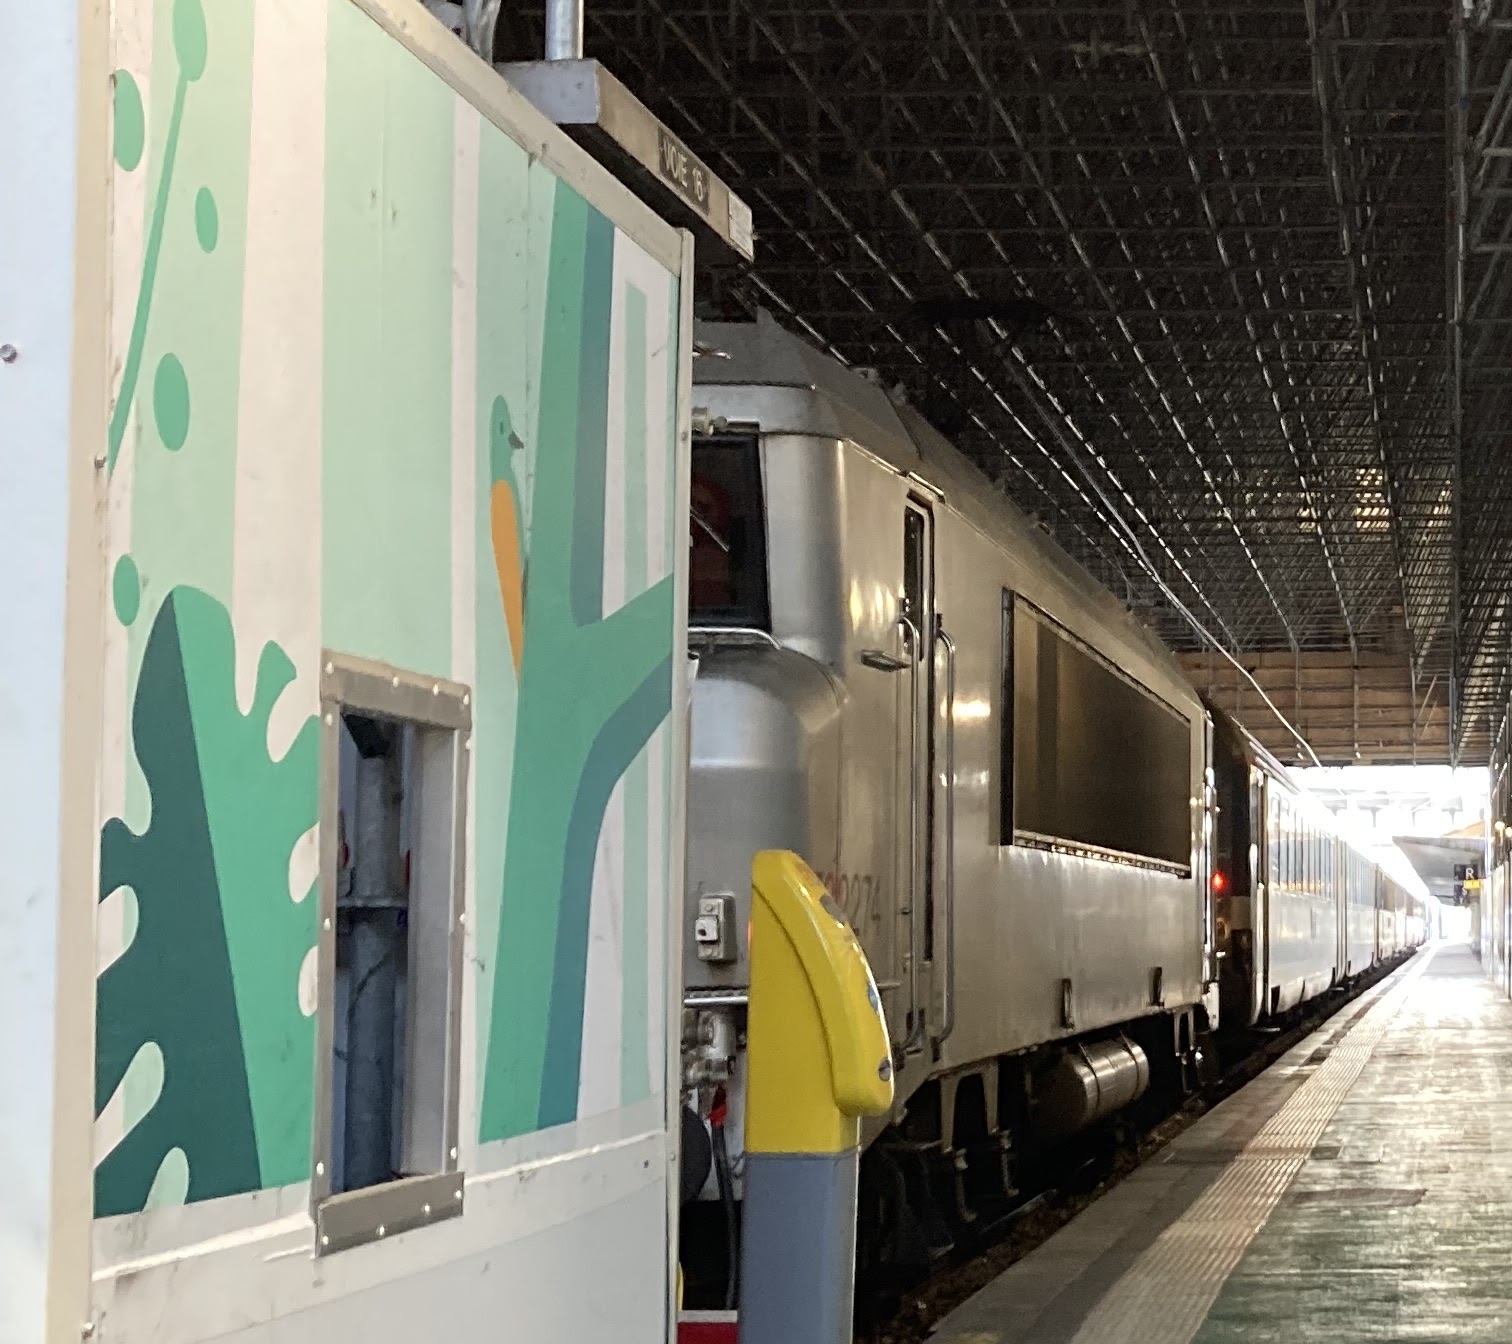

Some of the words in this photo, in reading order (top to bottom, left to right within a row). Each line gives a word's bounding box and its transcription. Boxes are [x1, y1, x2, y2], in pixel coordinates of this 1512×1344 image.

[663, 136, 688, 188] VOIE
[692, 166, 704, 202] 16
[1465, 867, 1475, 880] R
